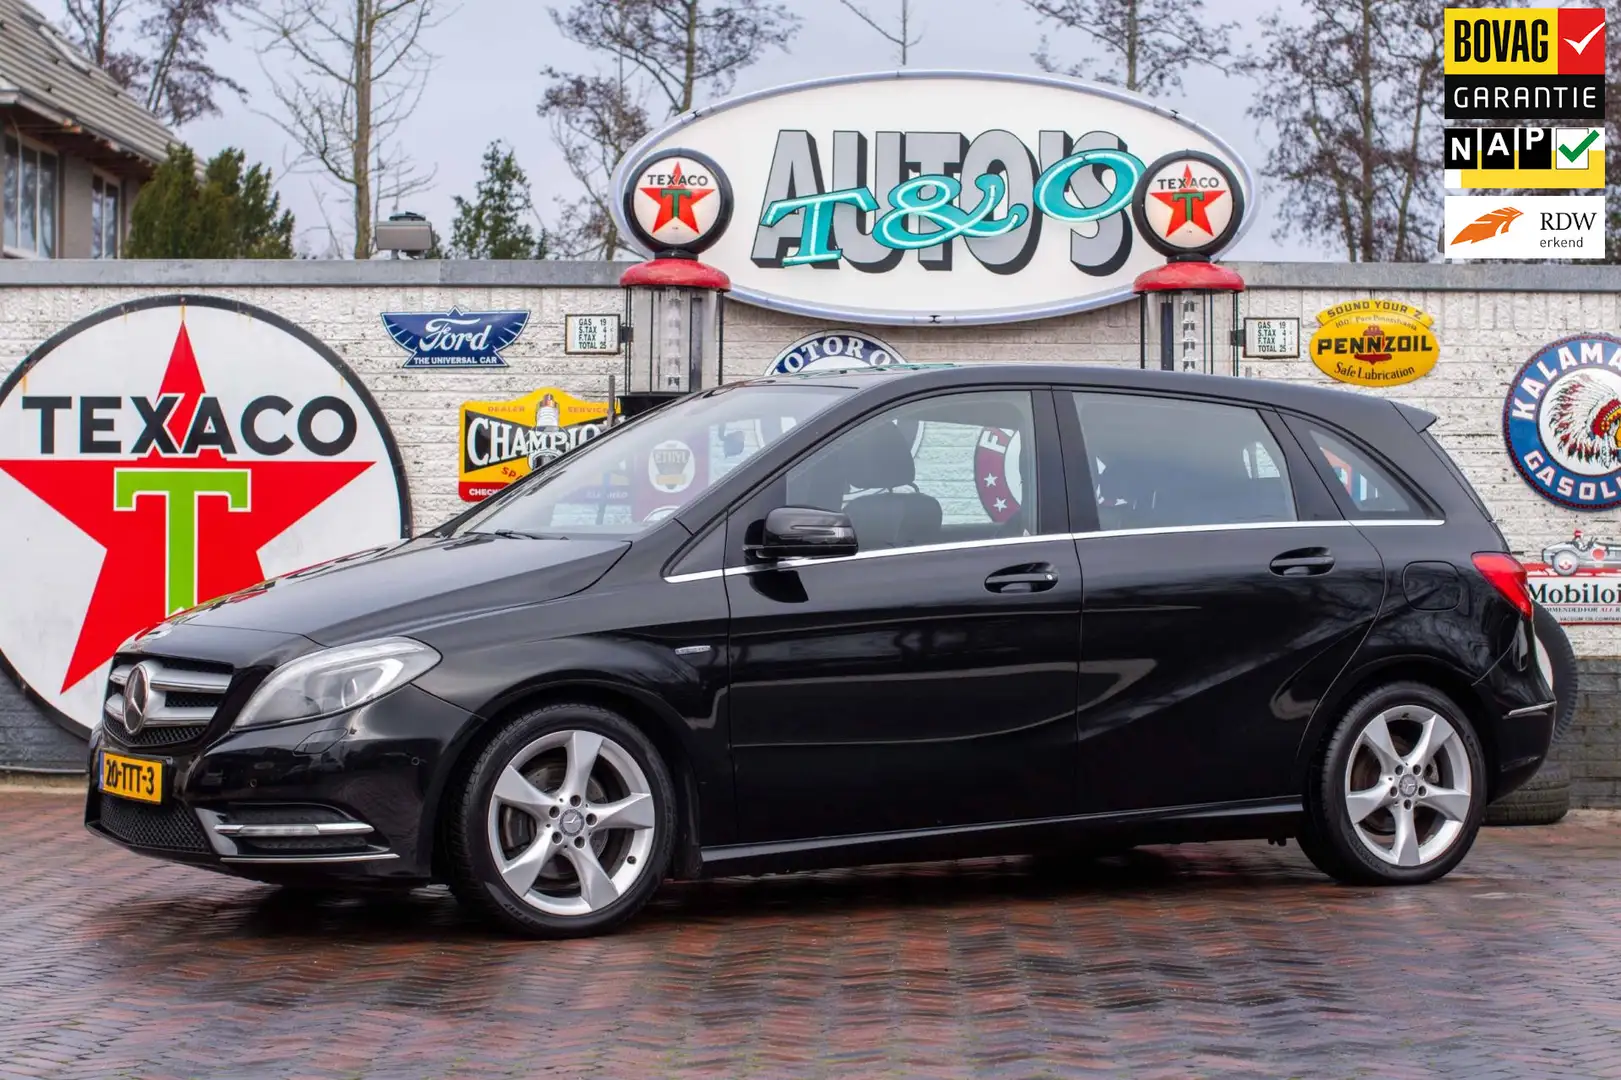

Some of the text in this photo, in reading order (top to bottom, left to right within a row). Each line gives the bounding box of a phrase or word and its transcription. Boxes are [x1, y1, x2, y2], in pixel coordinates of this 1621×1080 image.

[648, 174, 709, 186] TEXACO
[1157, 177, 1220, 190] TEXACO
[661, 188, 693, 219] T
[750, 129, 1134, 277] AUTO'S
[1172, 190, 1205, 222] T
[579, 318, 607, 326] GAS 19
[1258, 321, 1271, 329] GAS
[1327, 301, 1424, 320] SOUND YOUR Z
[419, 318, 493, 352] Ford
[1317, 335, 1433, 355] PENNZOIL
[480, 356, 498, 364] CAR
[775, 336, 864, 374] OTOR
[1334, 361, 1416, 381] Safe Lubrication
[22, 395, 357, 457] TEXACO
[467, 415, 626, 467] CHAMPIO
[113, 467, 252, 618] T
[106, 759, 154, 795] 20-TTT-3
